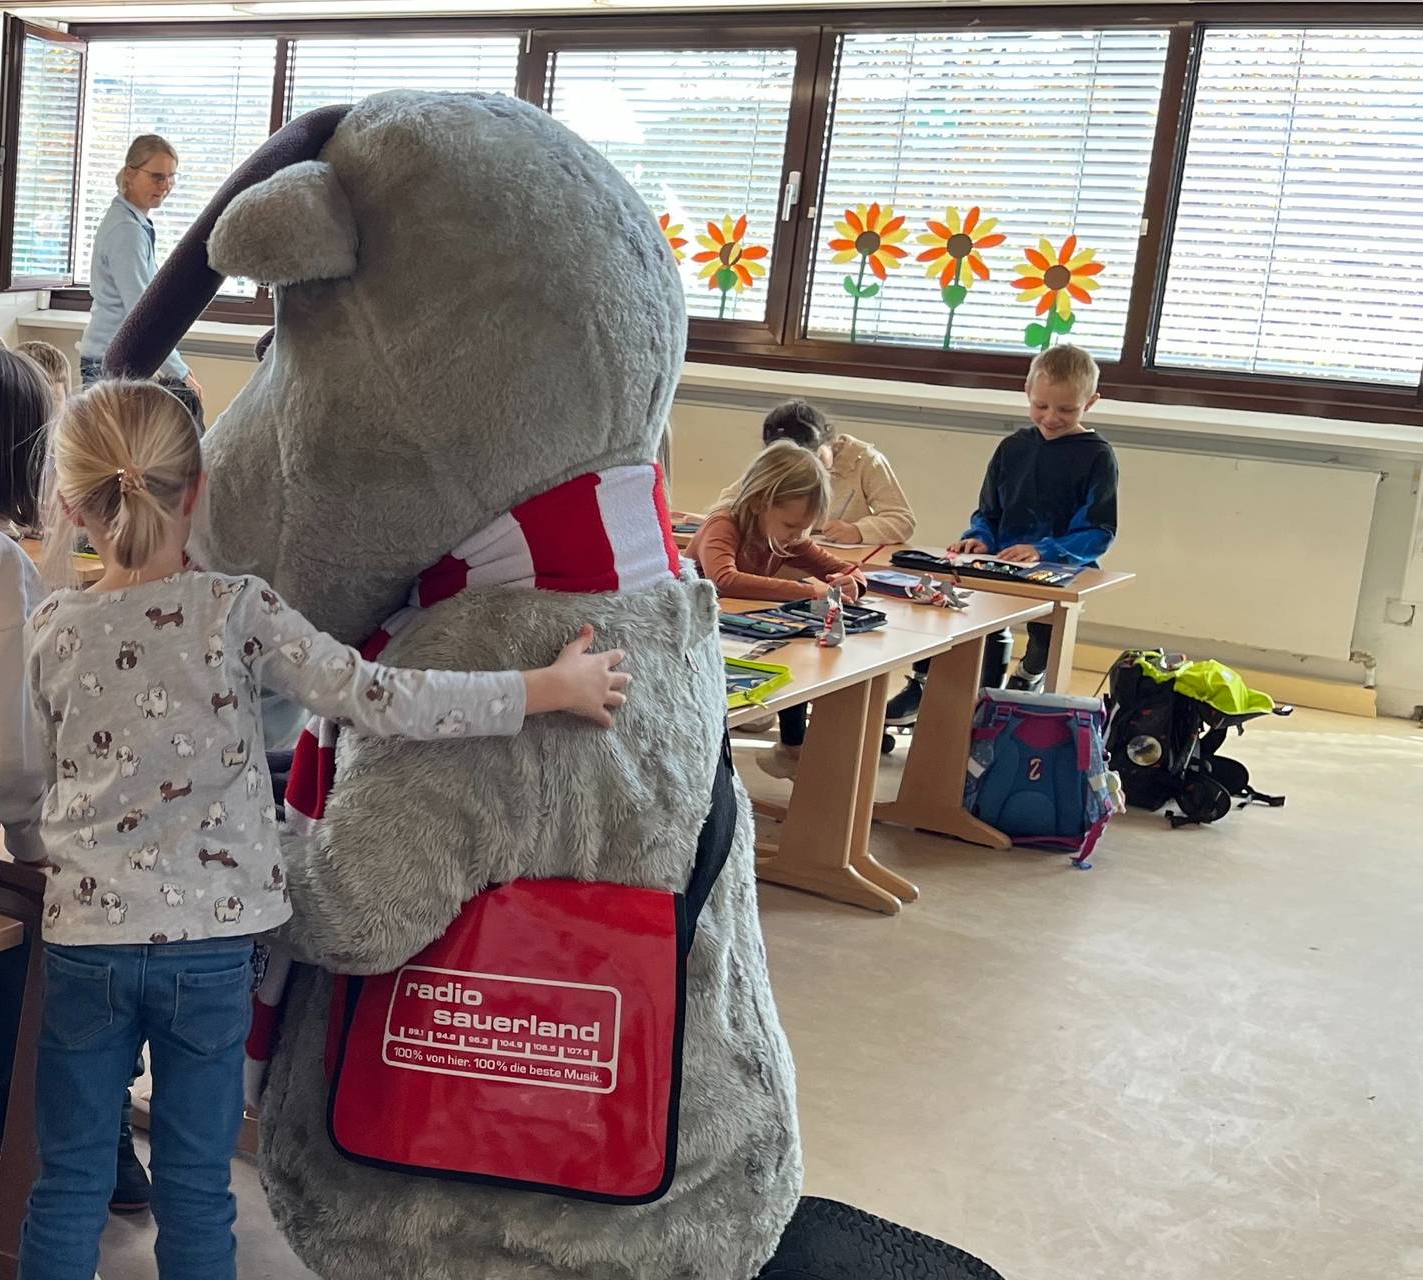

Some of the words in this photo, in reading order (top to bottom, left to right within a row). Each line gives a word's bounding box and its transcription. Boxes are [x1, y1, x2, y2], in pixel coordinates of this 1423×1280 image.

[405, 982, 483, 1006] radio
[433, 1009, 600, 1043] sauerland
[499, 1039, 523, 1049] 104.9
[394, 1046, 423, 1061] 100%
[426, 1053, 446, 1064] von
[447, 1054, 471, 1068] hier.
[473, 1057, 508, 1072] 100%
[509, 1062, 527, 1074] die
[529, 1065, 562, 1078] beste
[564, 1068, 603, 1083] Musik.
